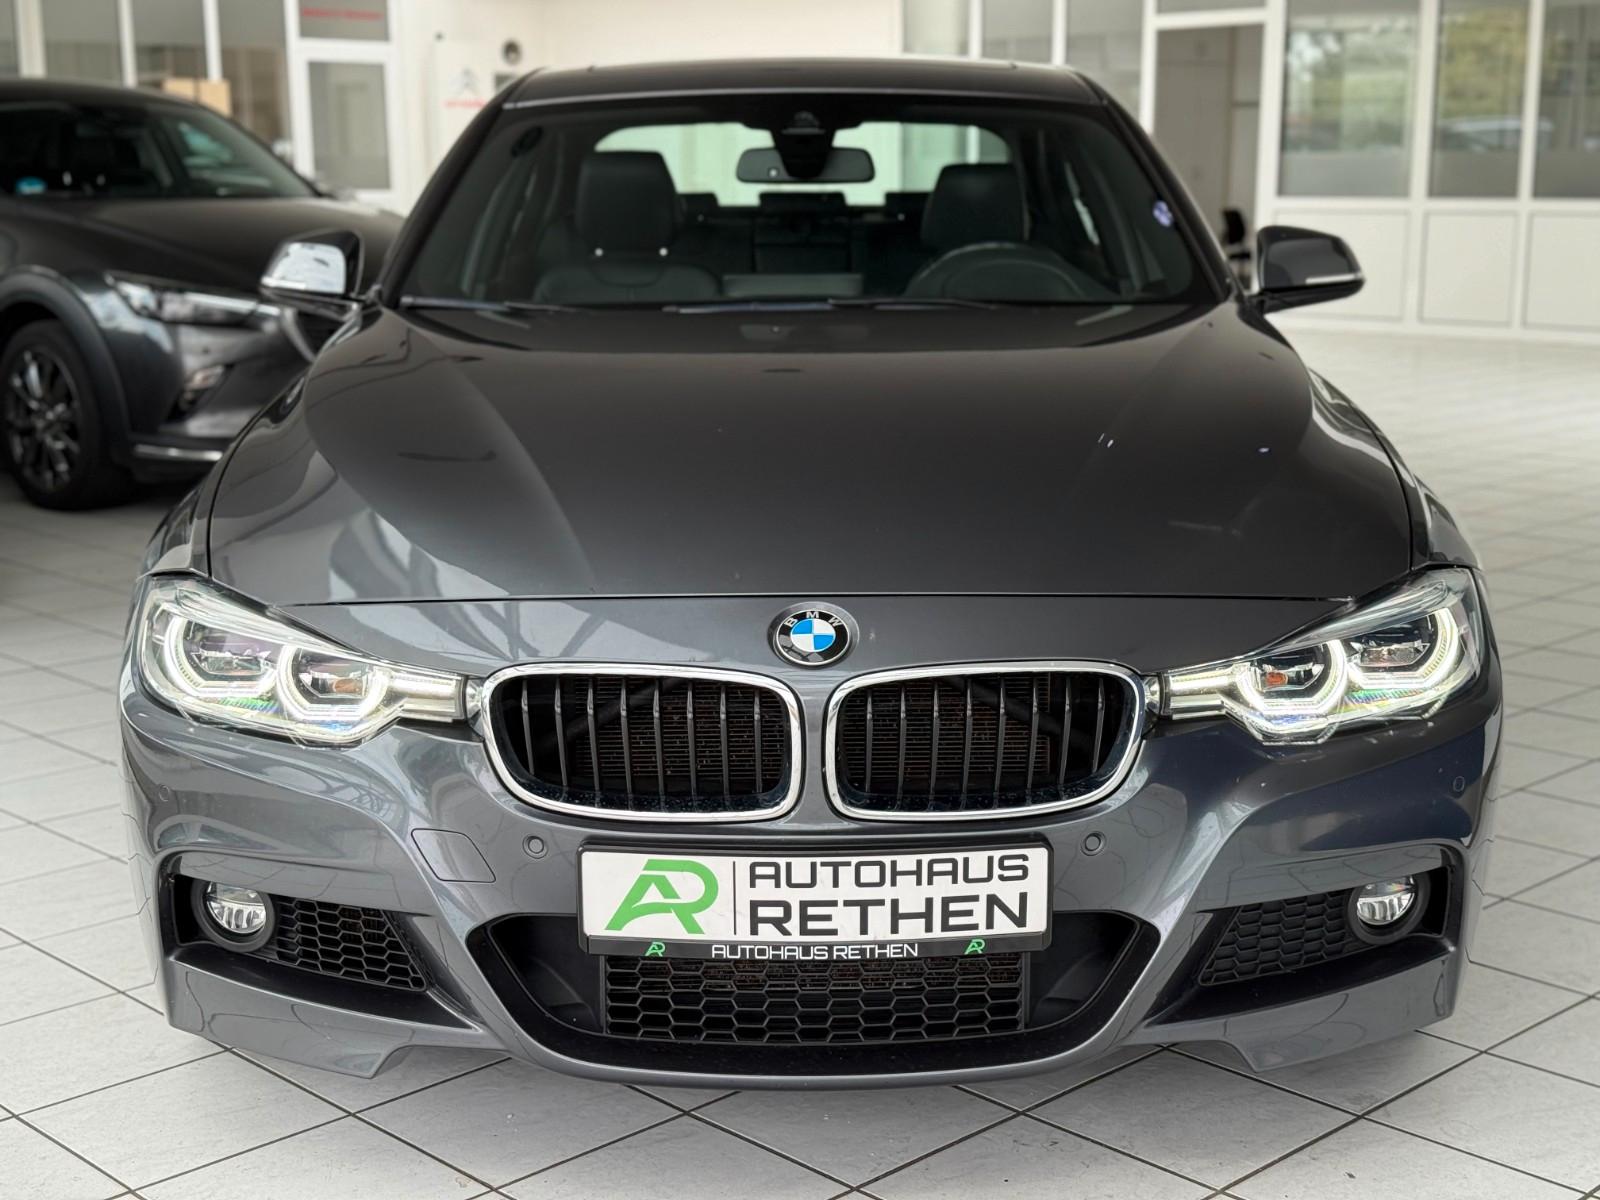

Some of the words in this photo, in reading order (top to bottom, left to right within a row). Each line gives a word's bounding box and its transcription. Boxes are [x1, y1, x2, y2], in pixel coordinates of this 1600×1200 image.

[783, 611, 843, 628] BMW
[749, 853, 1029, 889] AUTOHAUS
[749, 891, 1028, 936] RETHEN
[711, 944, 828, 960] AUTOHAUS
[833, 943, 918, 960] RETHEN
